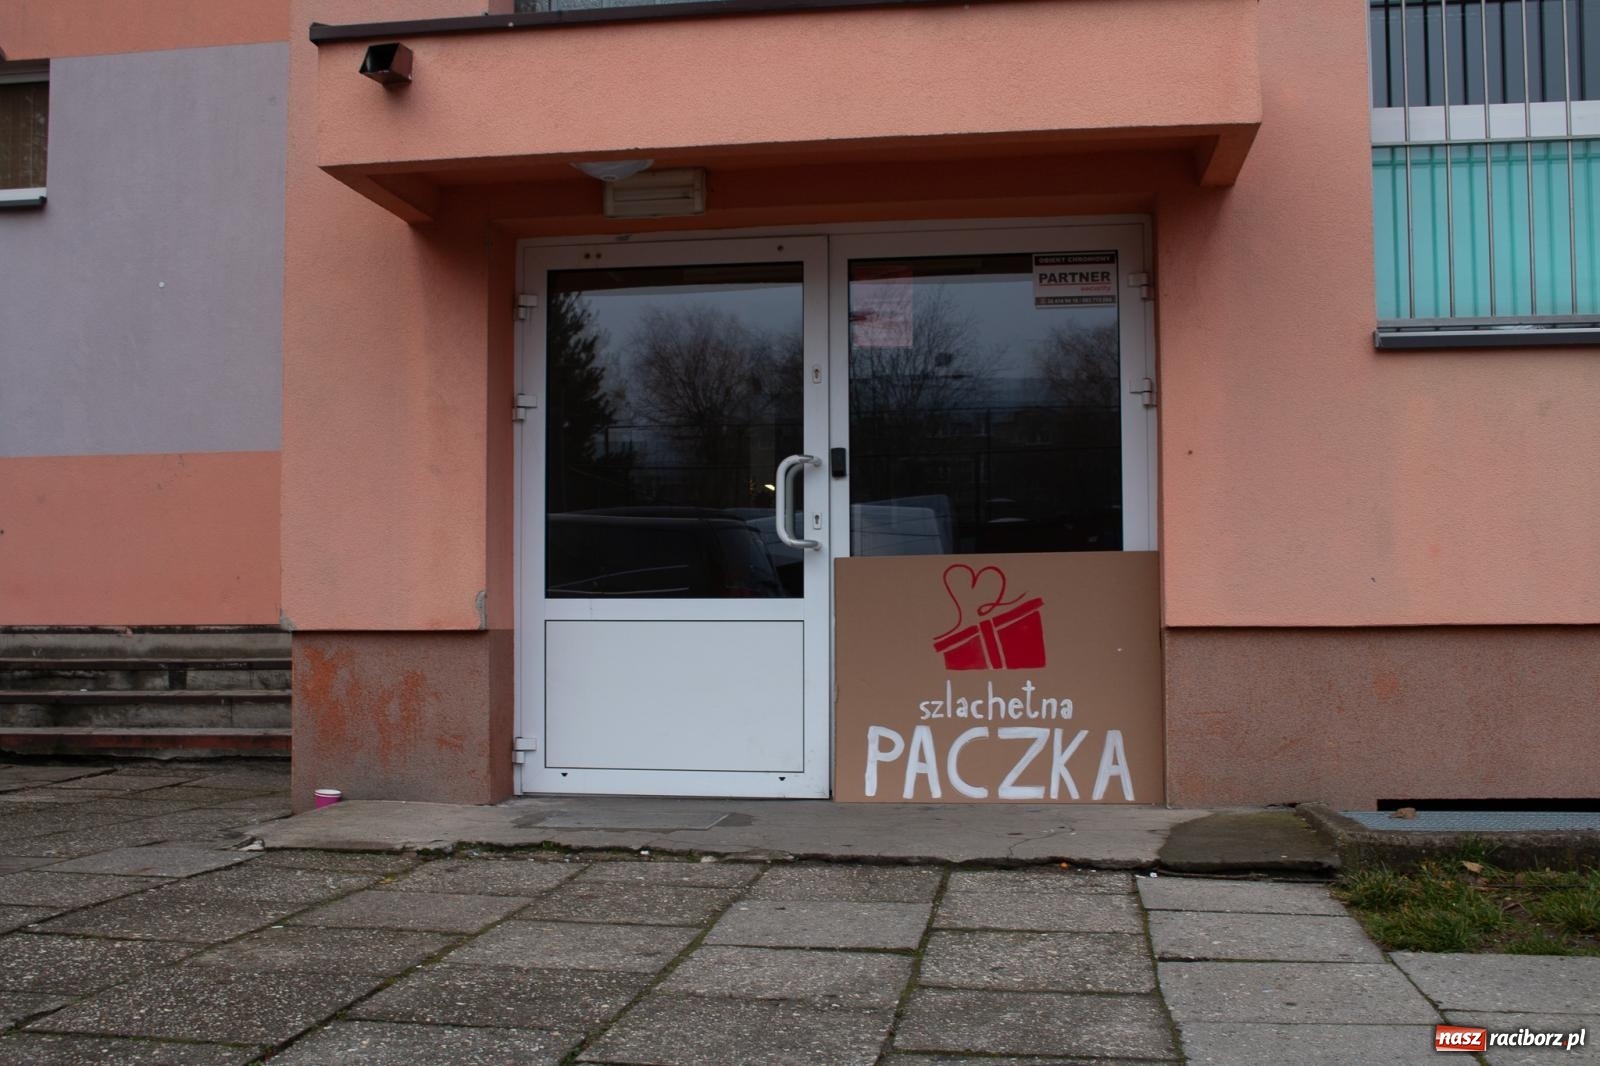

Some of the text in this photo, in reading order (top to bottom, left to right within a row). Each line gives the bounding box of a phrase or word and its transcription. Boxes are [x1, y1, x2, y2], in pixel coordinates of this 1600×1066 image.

[1039, 271, 1111, 283] PARTNER
[919, 680, 1073, 720] szlachetna
[865, 725, 1135, 801] PACZKA
